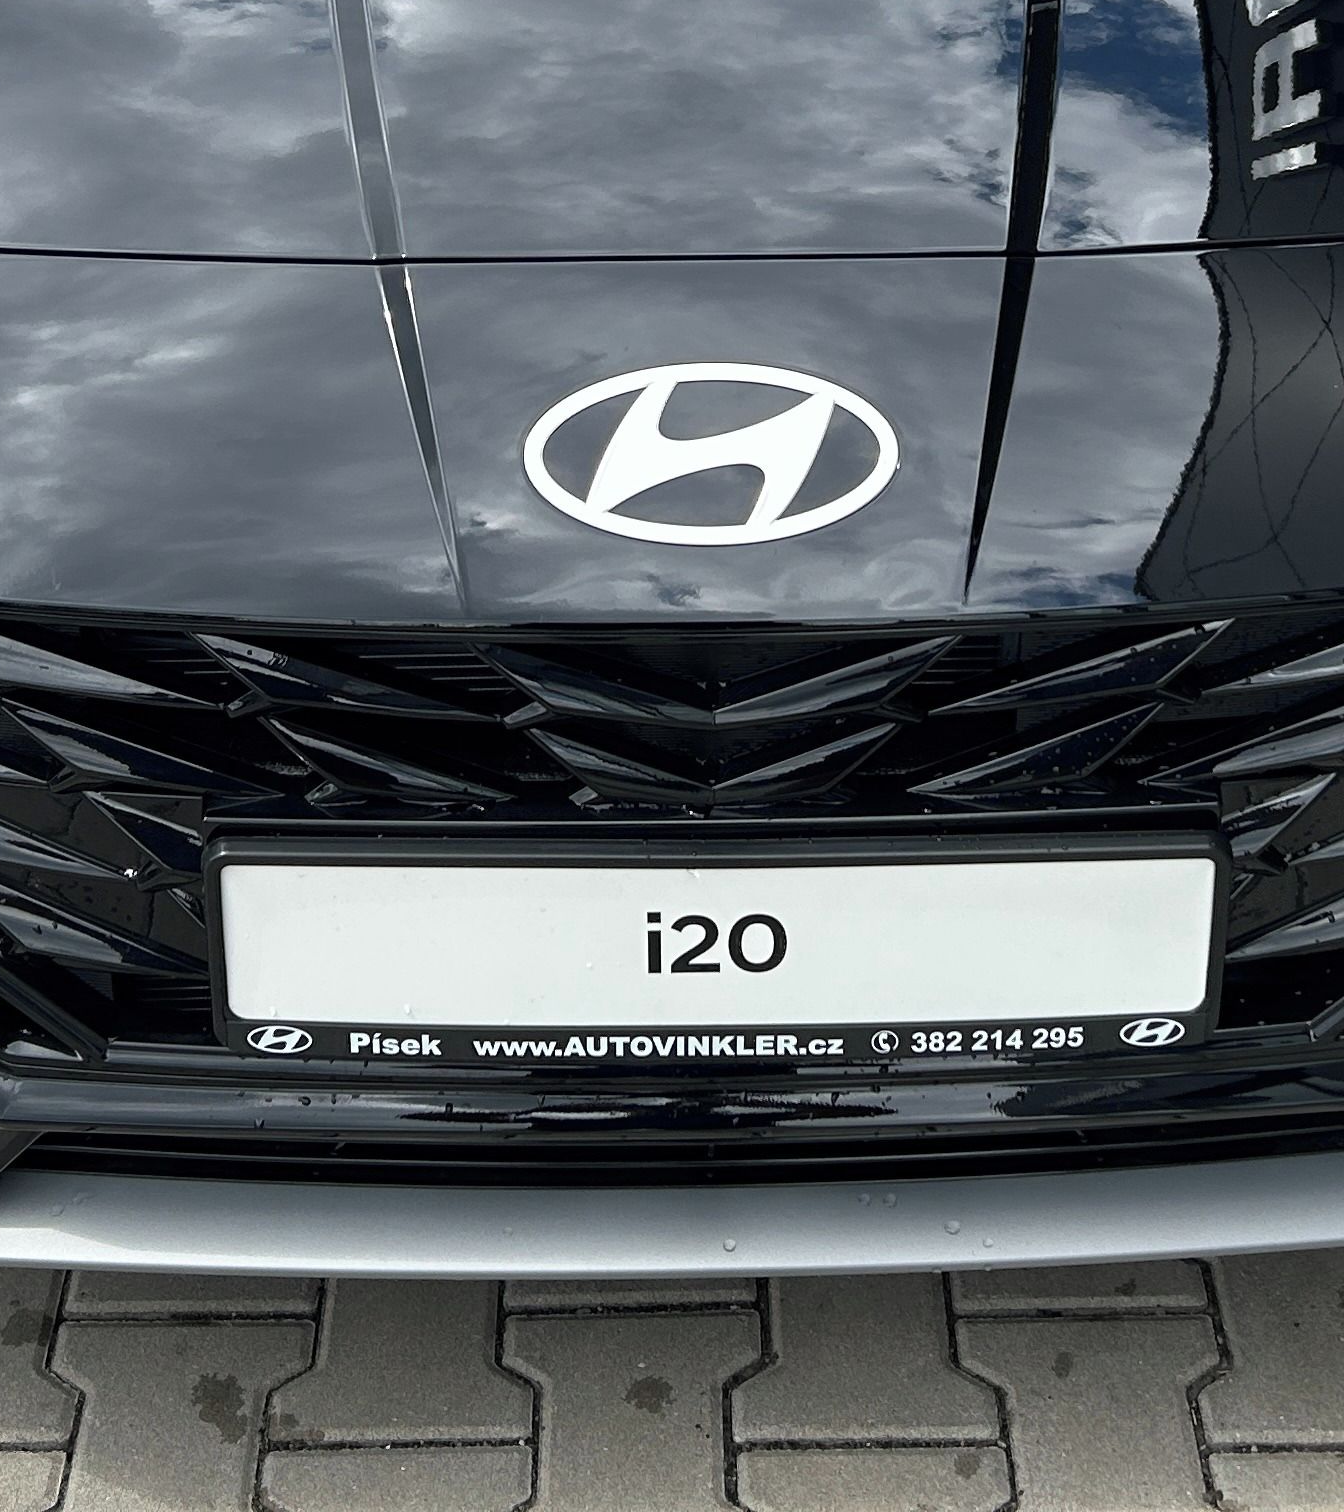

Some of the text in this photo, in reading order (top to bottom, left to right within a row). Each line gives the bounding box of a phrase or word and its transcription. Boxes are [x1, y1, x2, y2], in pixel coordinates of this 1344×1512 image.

[646, 912, 788, 974] i20
[350, 1027, 1084, 1057] Písek www.AUTOVINKLER.cz 382 214 295
